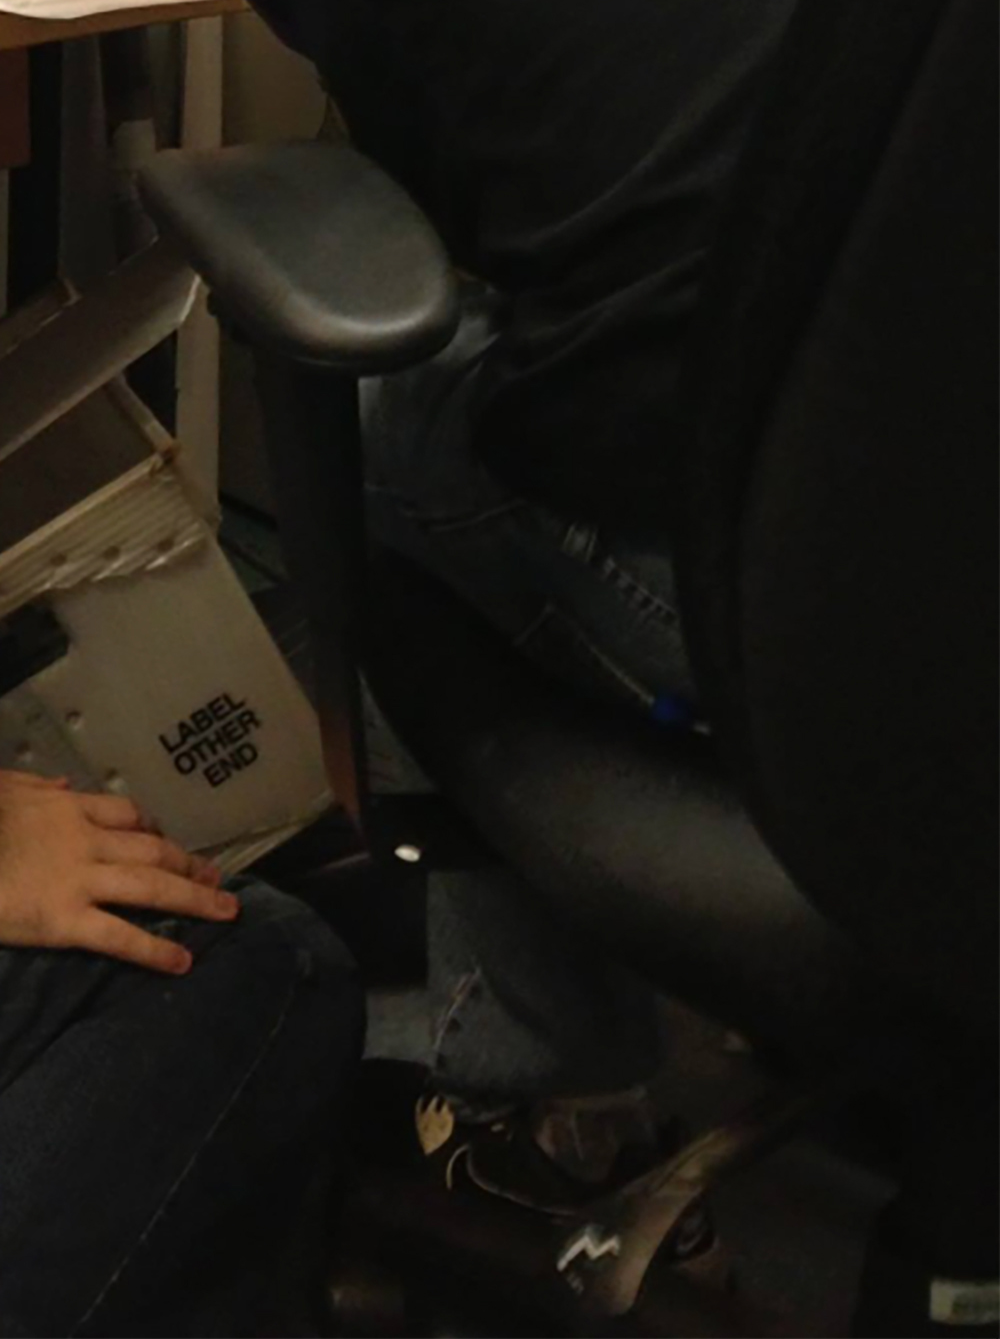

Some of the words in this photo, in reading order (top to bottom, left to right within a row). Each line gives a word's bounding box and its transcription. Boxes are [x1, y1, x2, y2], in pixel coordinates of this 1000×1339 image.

[159, 692, 246, 754] LABEL
[174, 709, 261, 775] OTHER
[203, 742, 259, 787] END
